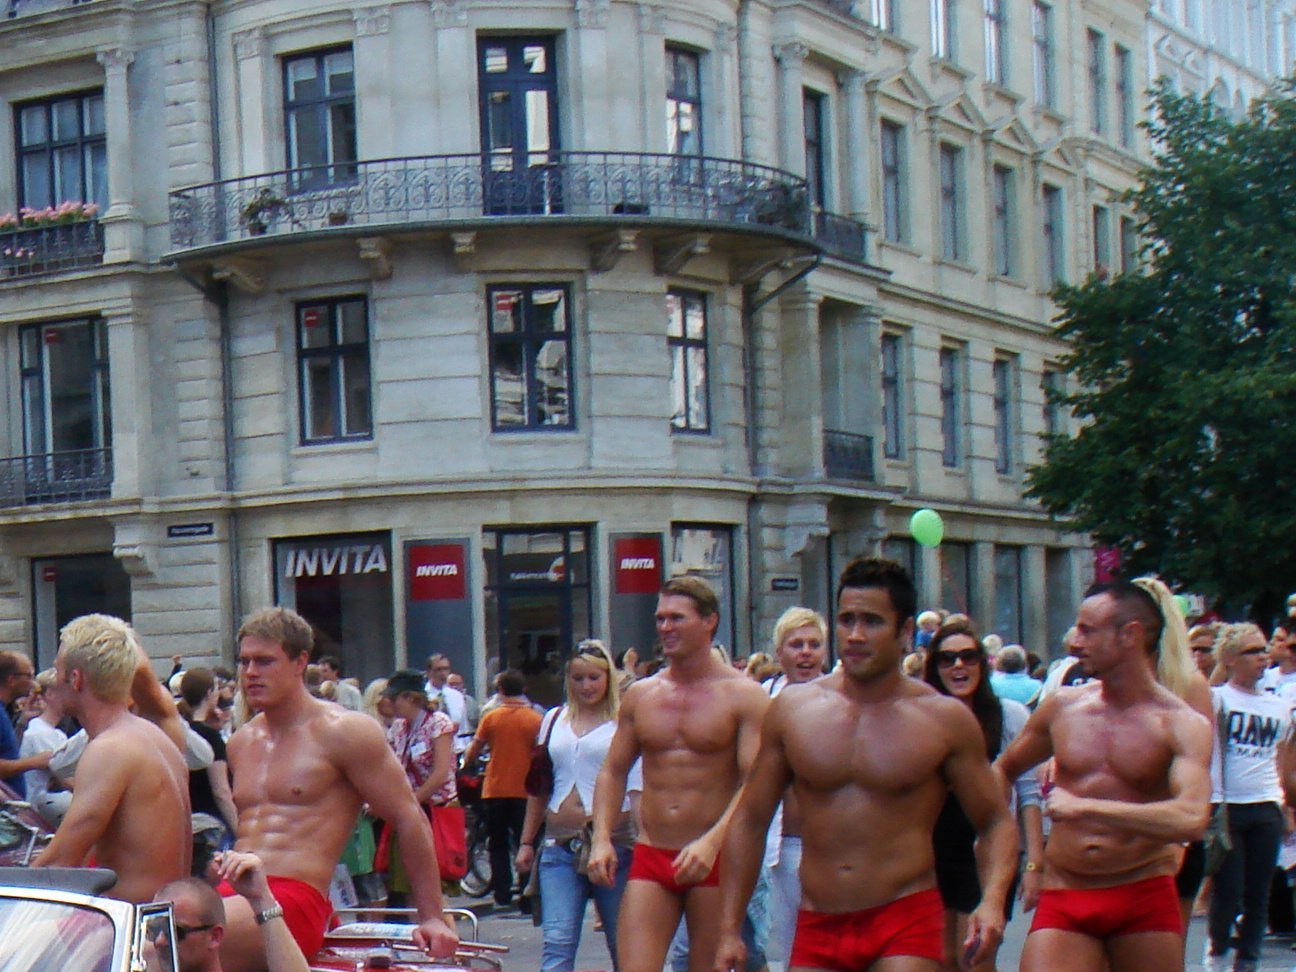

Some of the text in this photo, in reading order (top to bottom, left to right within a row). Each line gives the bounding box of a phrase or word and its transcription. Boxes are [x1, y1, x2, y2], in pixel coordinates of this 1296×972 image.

[285, 544, 387, 577] INVITA
[621, 558, 655, 569] INVITA
[416, 564, 458, 577] INVITA
